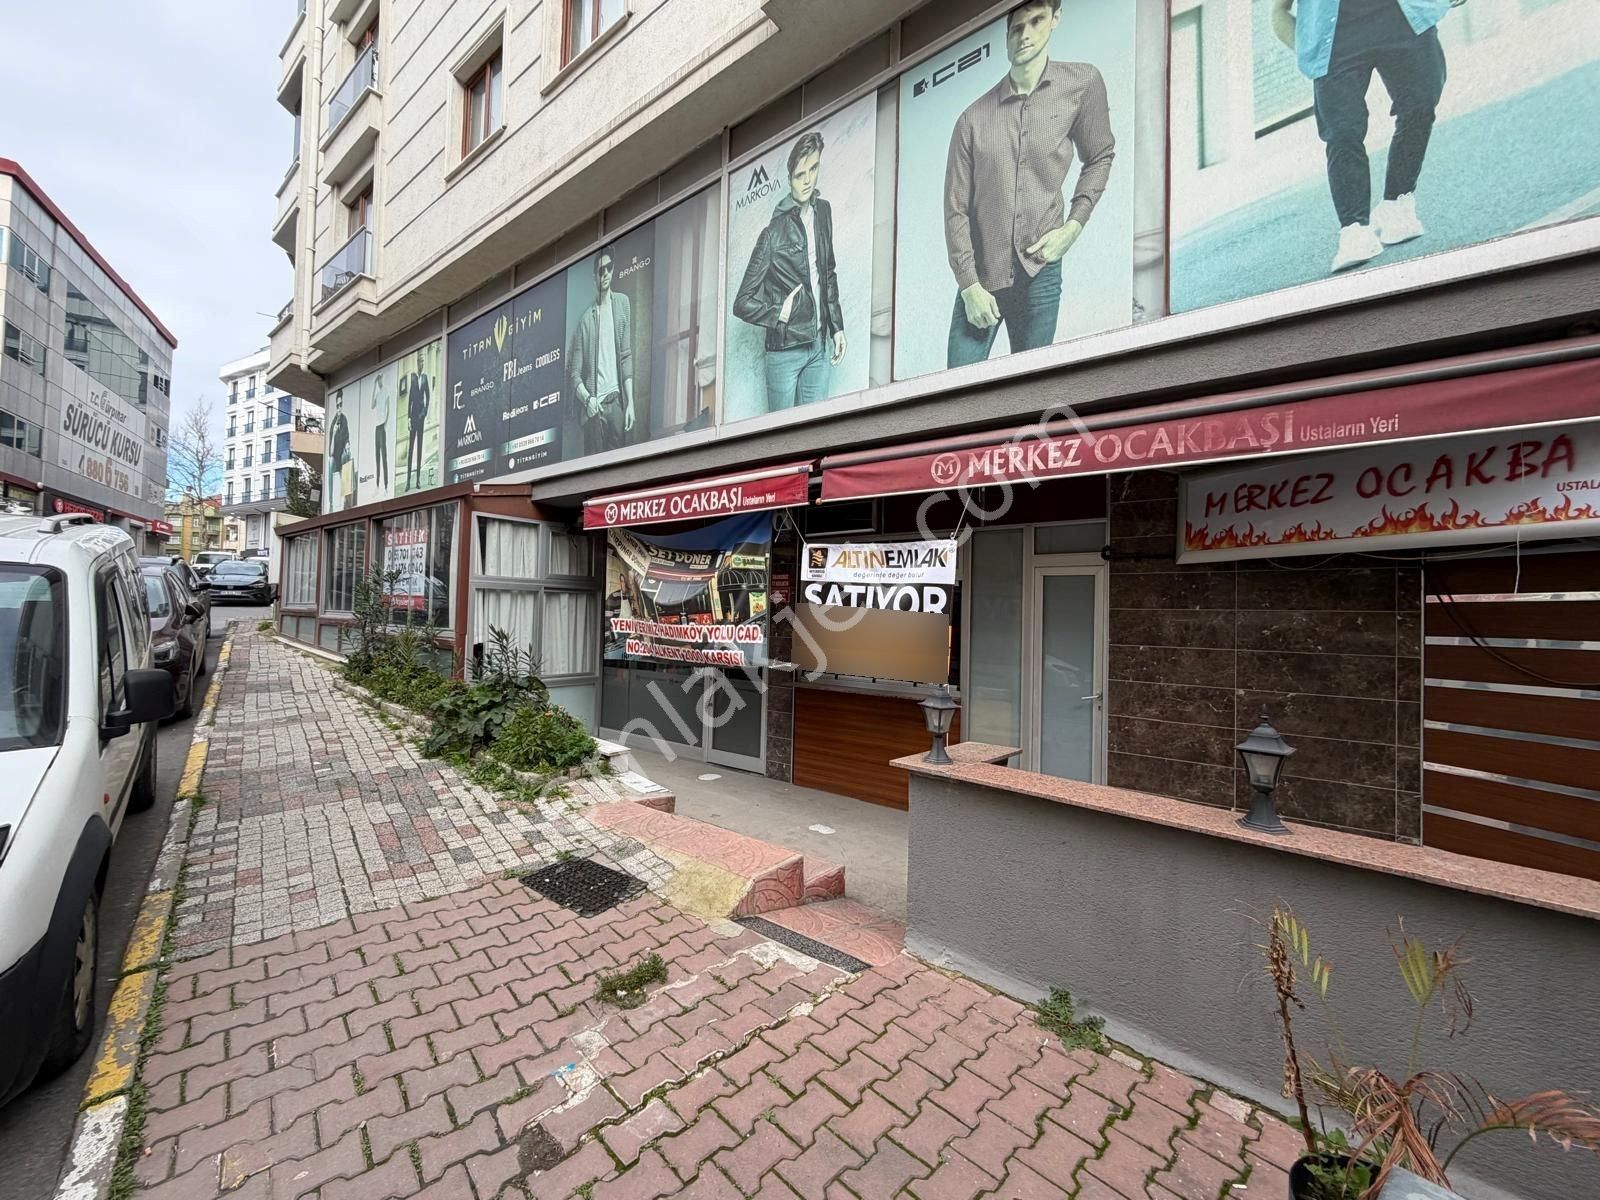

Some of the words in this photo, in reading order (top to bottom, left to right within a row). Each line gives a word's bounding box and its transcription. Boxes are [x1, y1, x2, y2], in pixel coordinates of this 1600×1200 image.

[736, 179, 781, 211] MARKOVA
[619, 257, 650, 278] BRANGO
[503, 358, 517, 382] FBI
[470, 381, 495, 397] BRANGO
[63, 402, 111, 450] SÜRÜCÜ
[110, 430, 142, 467] KURSU
[457, 430, 483, 449] MARKOVA
[967, 439, 1082, 478] MERKEZ
[1300, 421, 1365, 443] Ustaların
[1370, 413, 1400, 435] Yeri
[86, 457, 104, 482] 880
[104, 458, 113, 487] 6
[114, 468, 129, 493] 756
[1204, 473, 1336, 519] MERKEZ
[1356, 433, 1577, 499] OCAKBA
[1557, 479, 1600, 492] USTAL
[620, 498, 666, 521] MERKEZ
[670, 486, 742, 515] OCAKBAŞI
[804, 583, 947, 614] SATIYOR
[612, 617, 634, 633] YENİ
[660, 623, 703, 640] HADIMKÖY
[706, 626, 734, 640] YOLU
[737, 626, 763, 641] CAD.
